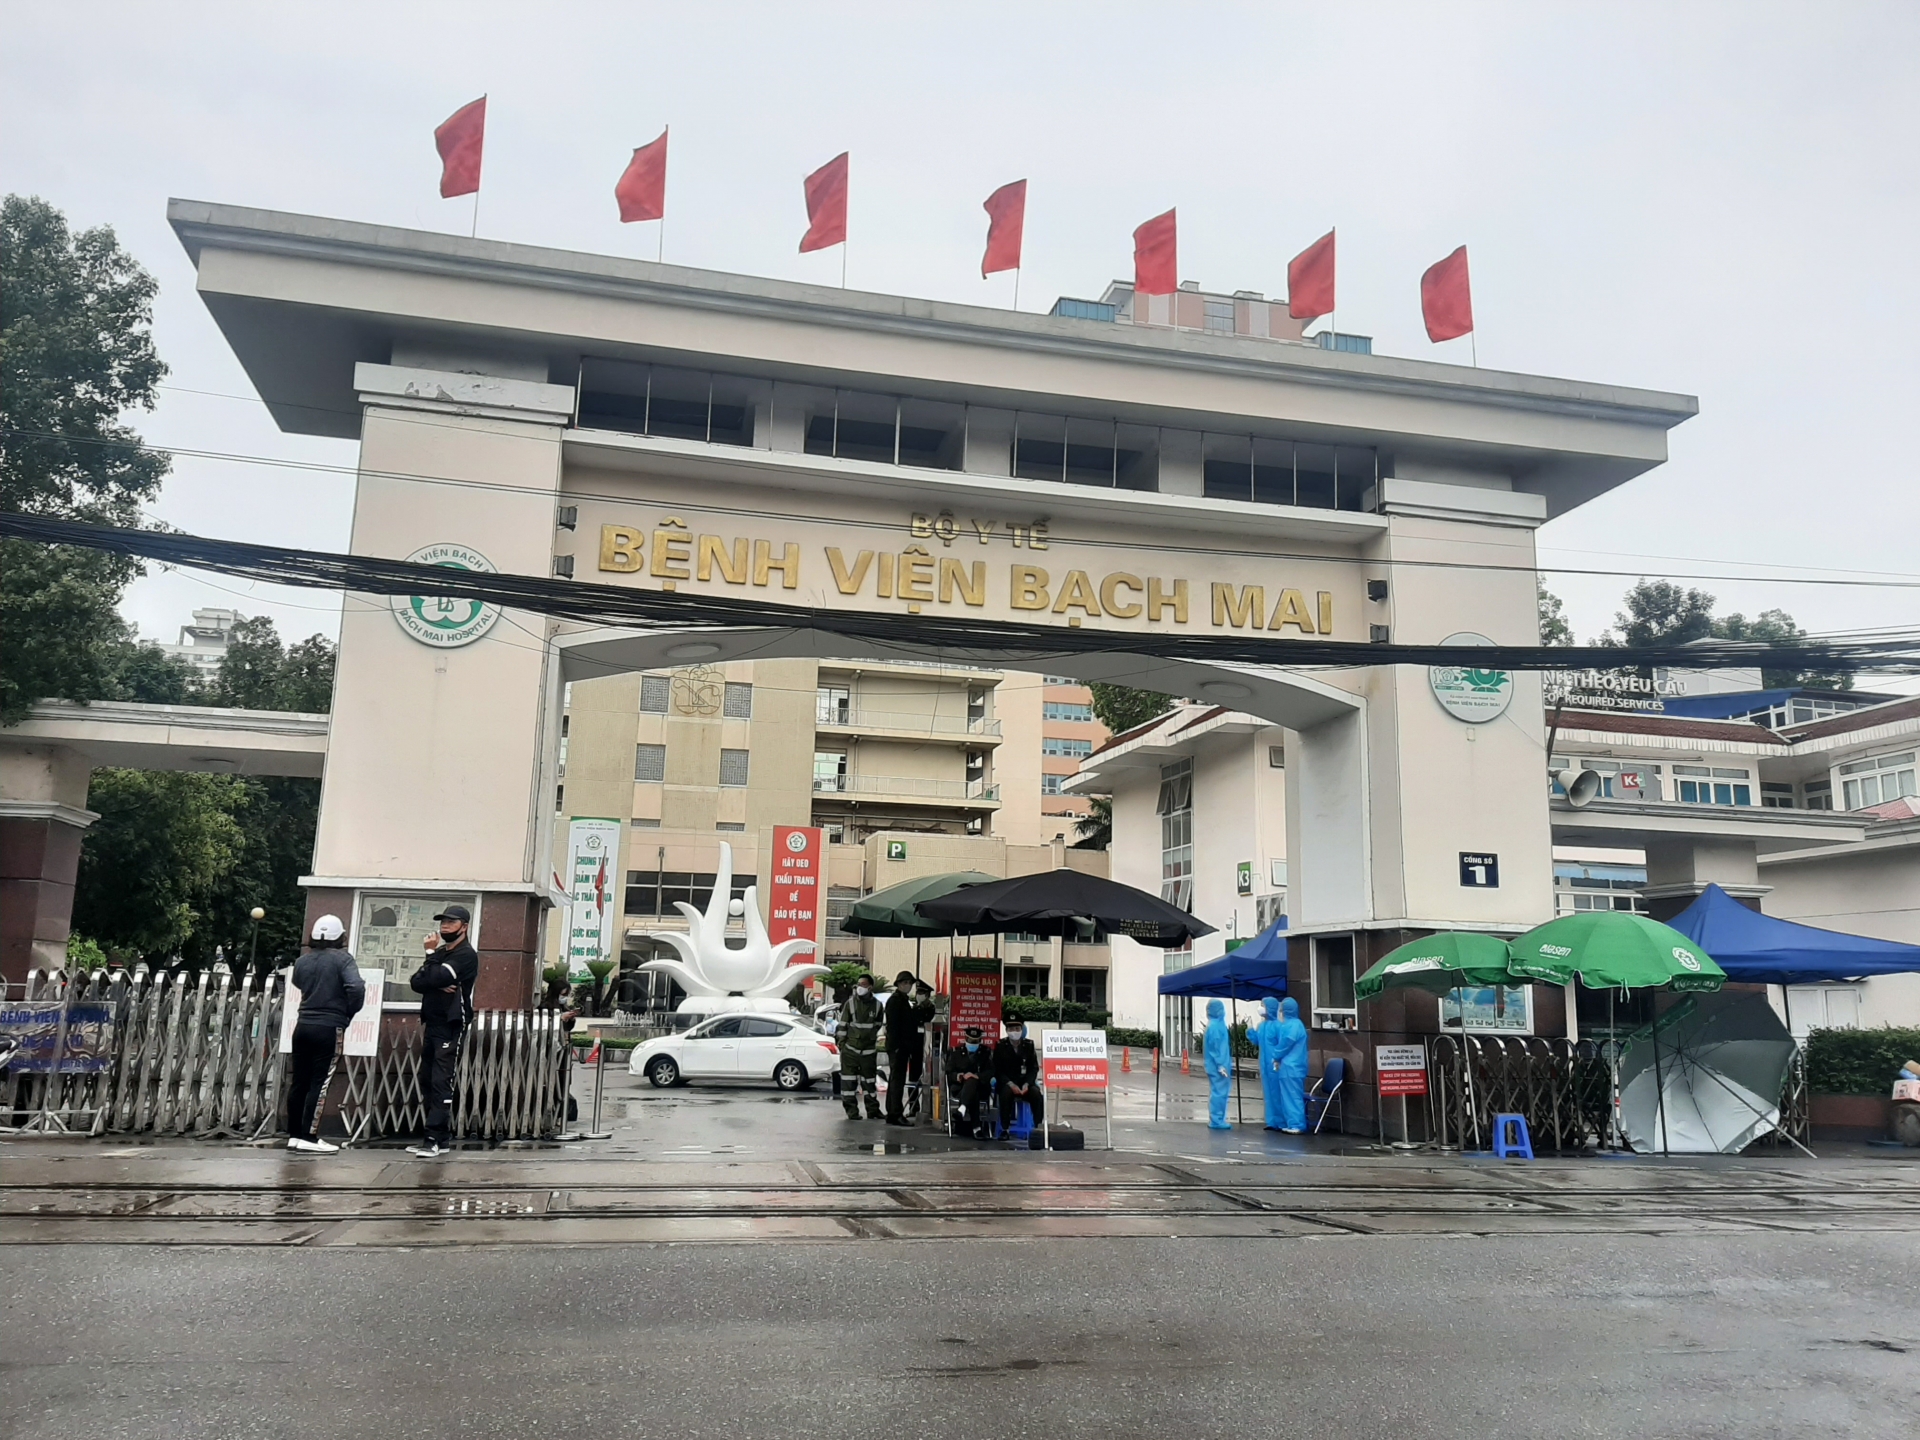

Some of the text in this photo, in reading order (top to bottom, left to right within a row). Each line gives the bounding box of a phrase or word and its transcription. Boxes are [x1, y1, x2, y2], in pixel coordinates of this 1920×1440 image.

[910, 509, 1051, 551] BỘ Y TẾ
[421, 548, 484, 569] VIỆN BẠCH
[599, 516, 1333, 635] BỆNH VIỆN BẠCH MAI
[422, 630, 444, 642] MAI
[447, 613, 493, 642] HOSPITAL
[1572, 672, 1615, 690] THEO
[1620, 674, 1651, 693] YÊU
[1565, 694, 1615, 707] REQUIRED
[1617, 698, 1665, 711] SERVICES
[891, 843, 902, 857] P
[576, 856, 610, 866] CHUNG TY
[794, 875, 815, 885] TRANG
[1239, 870, 1250, 887] K3
[1468, 865, 1486, 884] 1
[982, 976, 997, 986] BÁO
